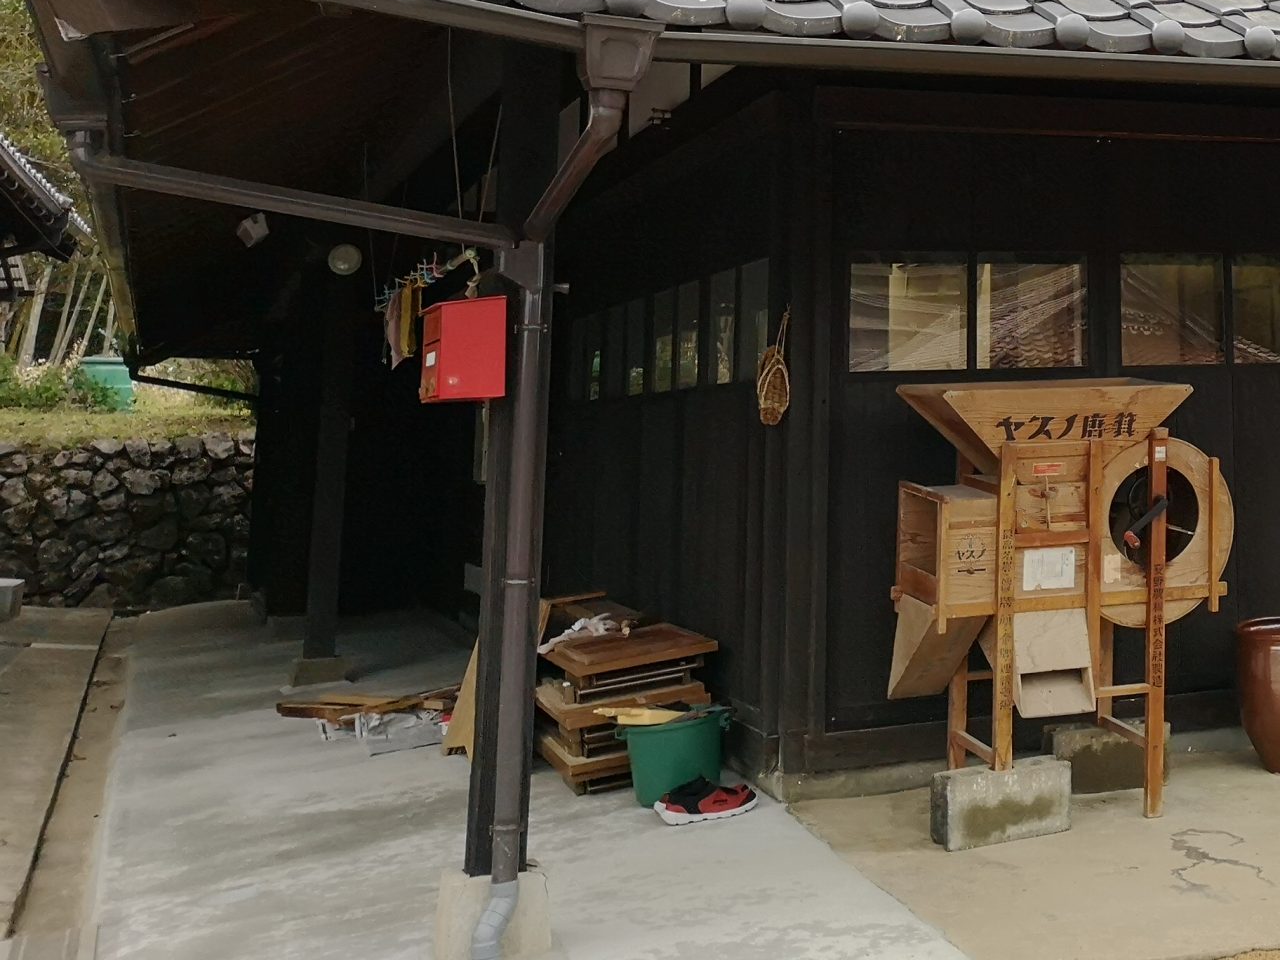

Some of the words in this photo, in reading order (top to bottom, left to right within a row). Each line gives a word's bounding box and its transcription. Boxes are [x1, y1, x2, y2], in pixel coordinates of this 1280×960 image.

[995, 411, 1137, 442] ヤスノ唐箕
[955, 548, 987, 561] ヤスノ
